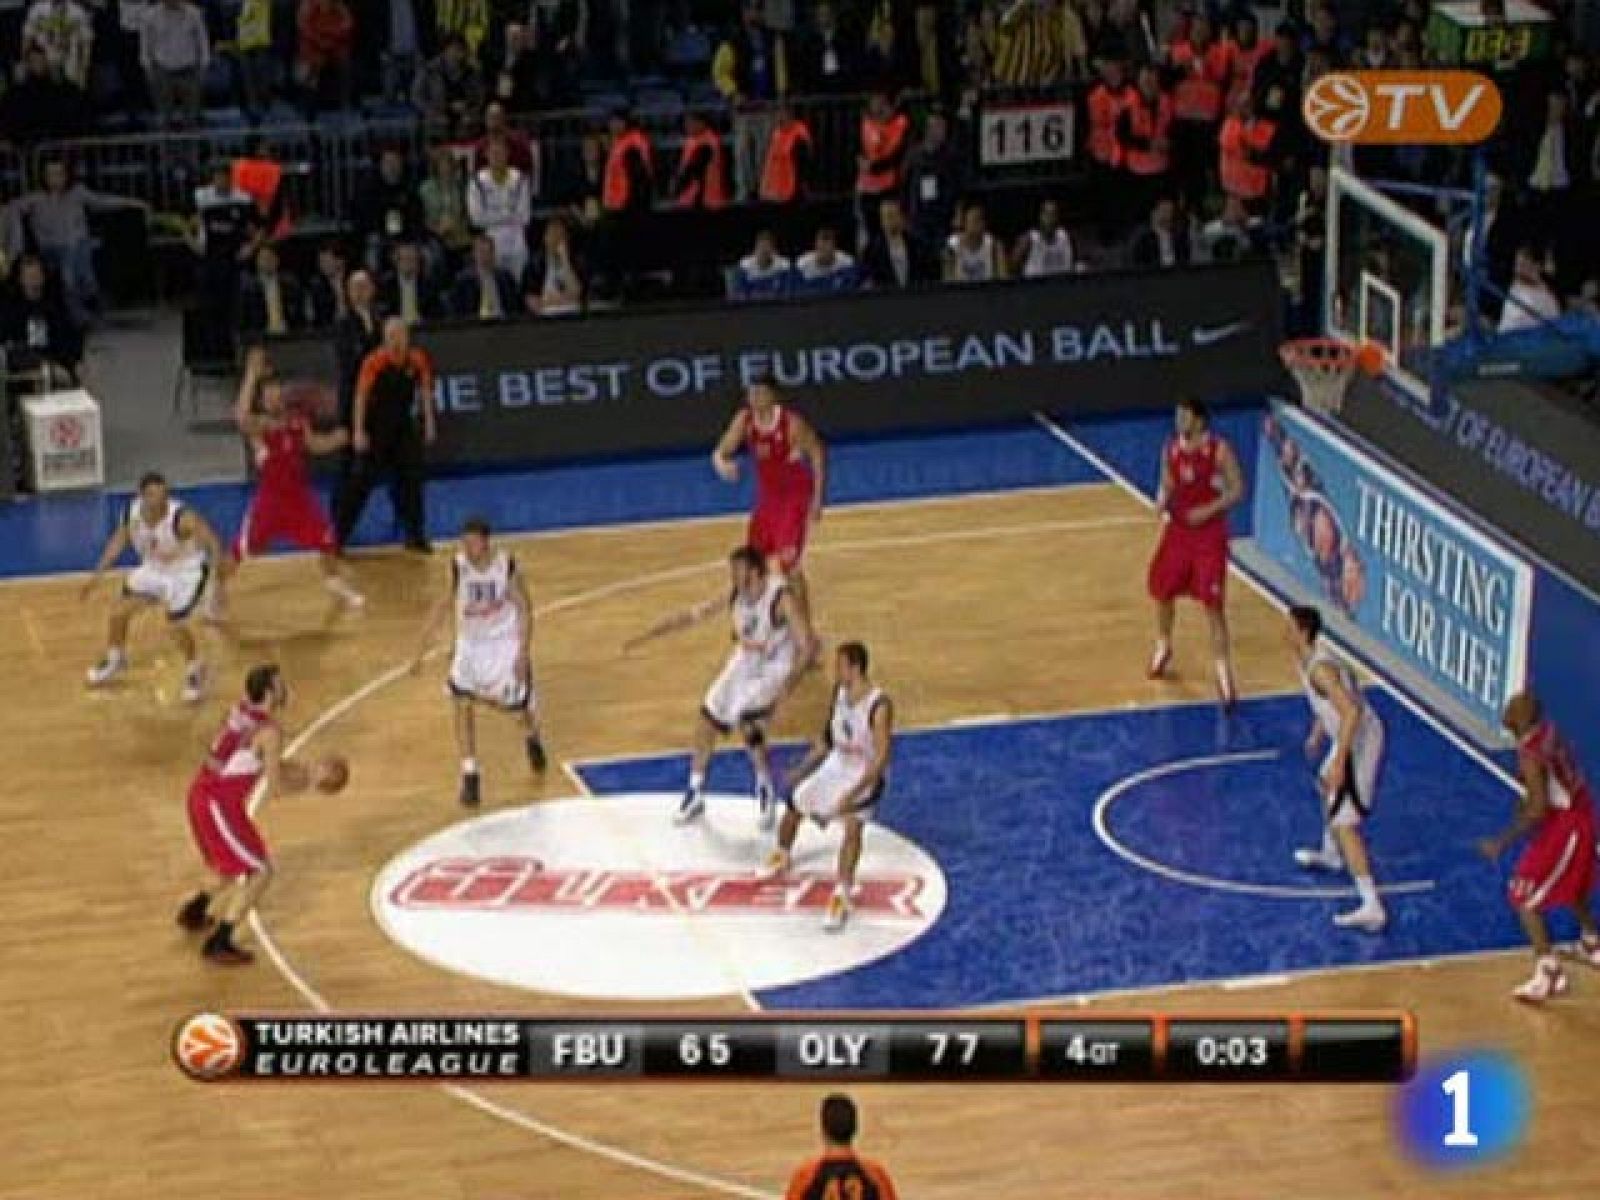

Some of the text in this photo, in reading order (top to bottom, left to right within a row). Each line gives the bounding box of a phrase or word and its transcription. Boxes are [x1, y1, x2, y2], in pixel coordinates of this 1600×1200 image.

[990, 114, 1064, 157] 116
[499, 362, 629, 407] BEST
[645, 354, 721, 397] OF
[738, 330, 1034, 388] EUROPEAN
[1051, 320, 1180, 362] BALL
[1355, 476, 1507, 636] THIRSTING
[1382, 574, 1500, 710] FOR LIFE
